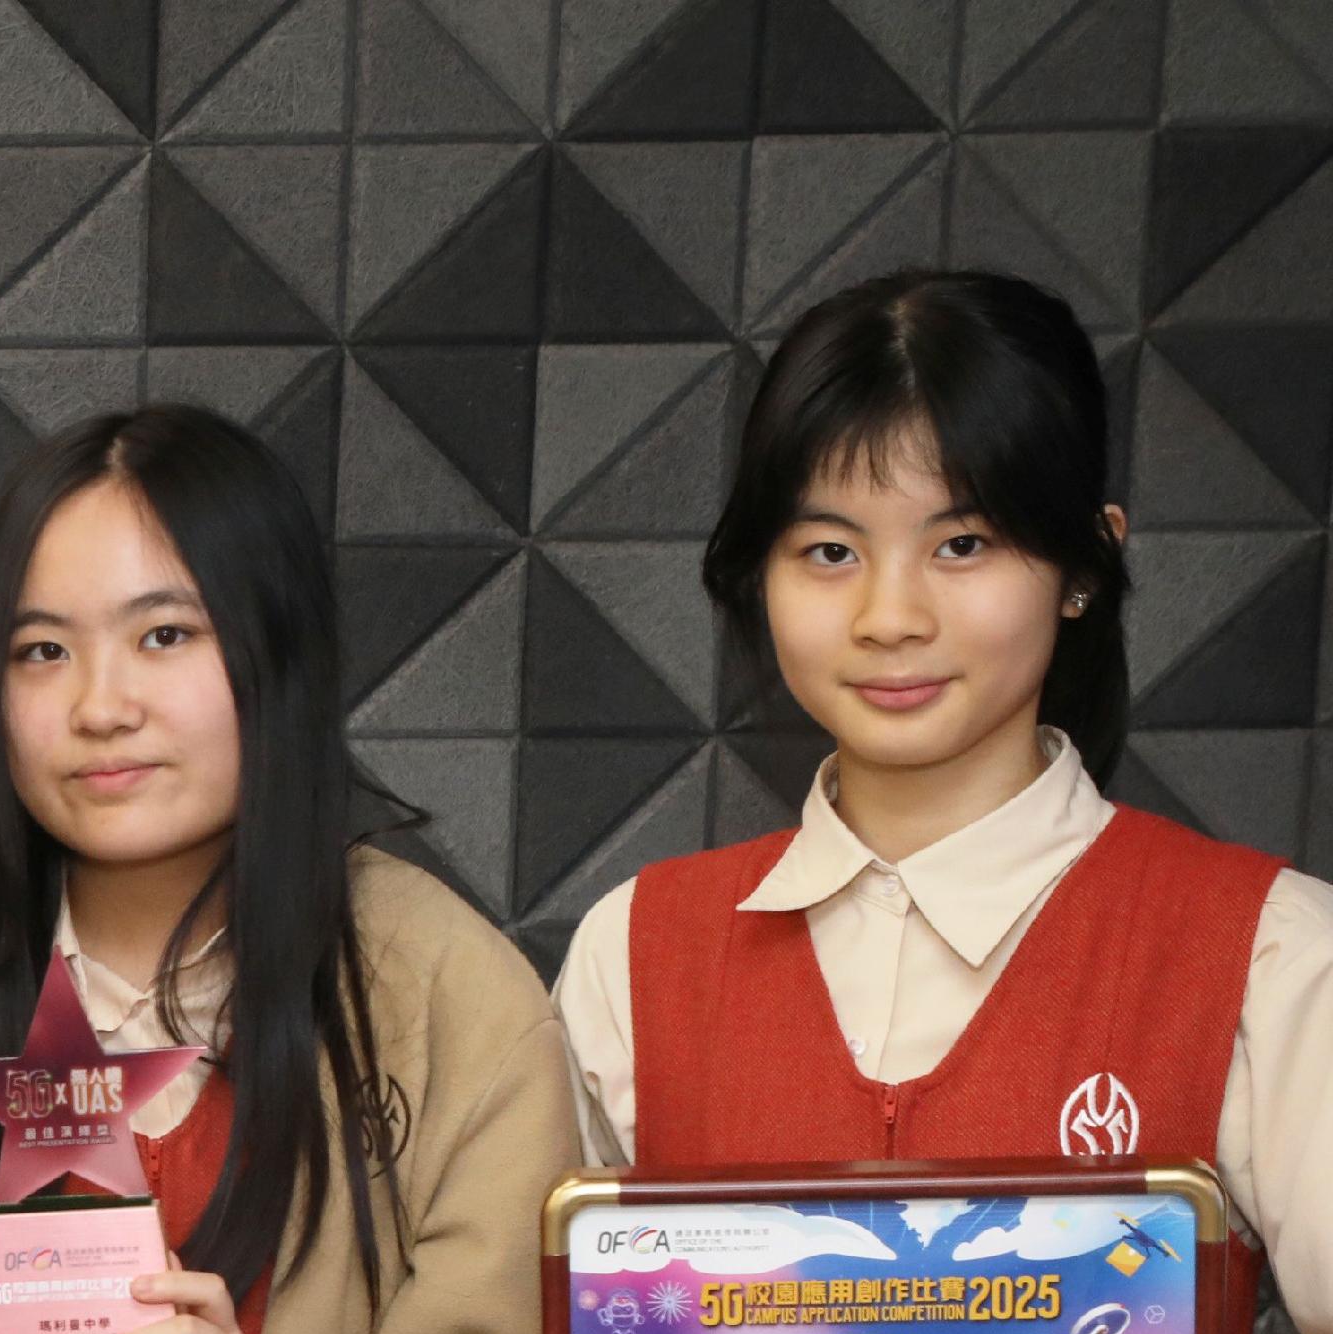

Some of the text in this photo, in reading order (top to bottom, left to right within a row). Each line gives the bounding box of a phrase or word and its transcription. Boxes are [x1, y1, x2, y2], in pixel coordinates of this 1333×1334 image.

[6, 1069, 53, 1119] 5G
[73, 1083, 123, 1115] UAS
[700, 1282, 743, 1326] 5G
[968, 1274, 1061, 1320] 2025
[746, 1304, 965, 1325] CAMPUS APPLICATION COMPETITION
